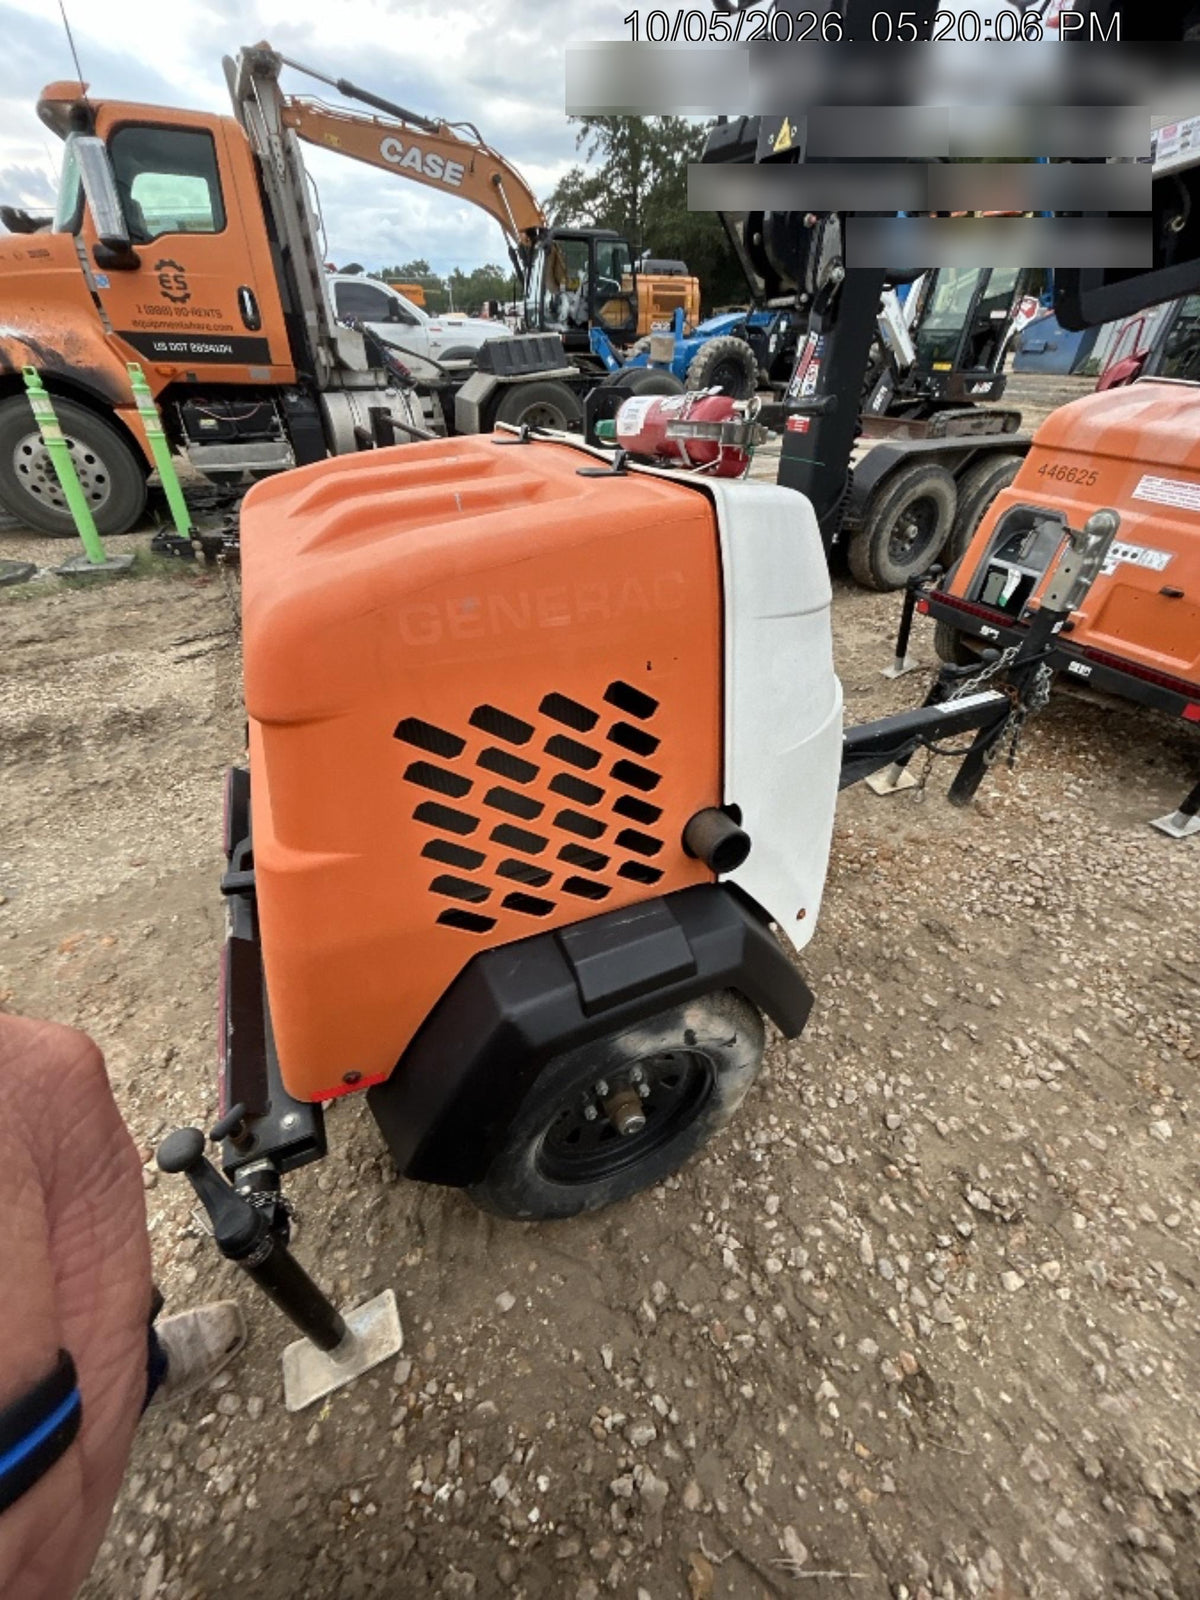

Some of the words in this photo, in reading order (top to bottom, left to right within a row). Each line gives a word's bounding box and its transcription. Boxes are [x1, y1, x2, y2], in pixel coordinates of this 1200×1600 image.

[379, 136, 465, 187] CASE
[158, 273, 188, 290] ES
[153, 341, 168, 351] US
[1037, 463, 1099, 486] 446625
[400, 570, 686, 646] GENERAC
